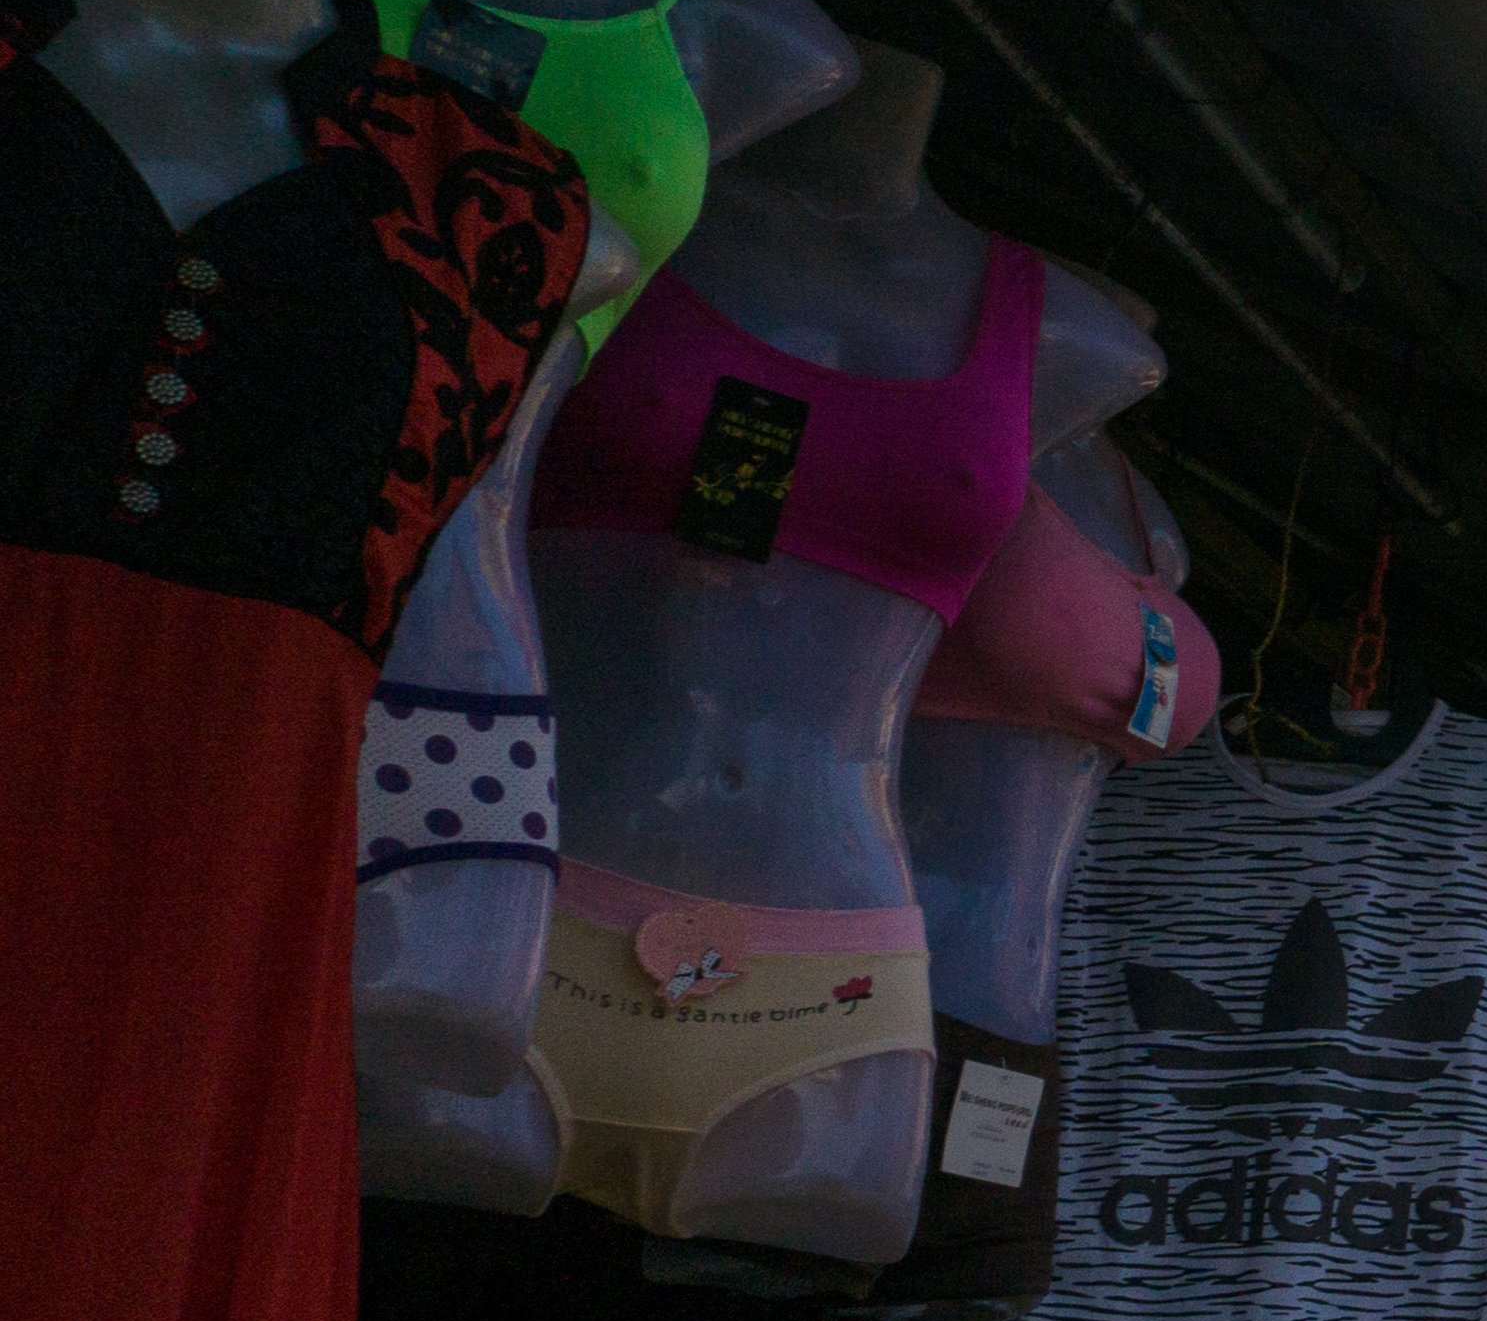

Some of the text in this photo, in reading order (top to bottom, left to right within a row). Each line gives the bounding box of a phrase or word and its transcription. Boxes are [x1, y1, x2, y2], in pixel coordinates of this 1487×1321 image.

[546, 970, 610, 1008] This
[618, 998, 641, 1016] is
[651, 1004, 665, 1019] a
[1100, 1152, 1467, 1254] adidas
